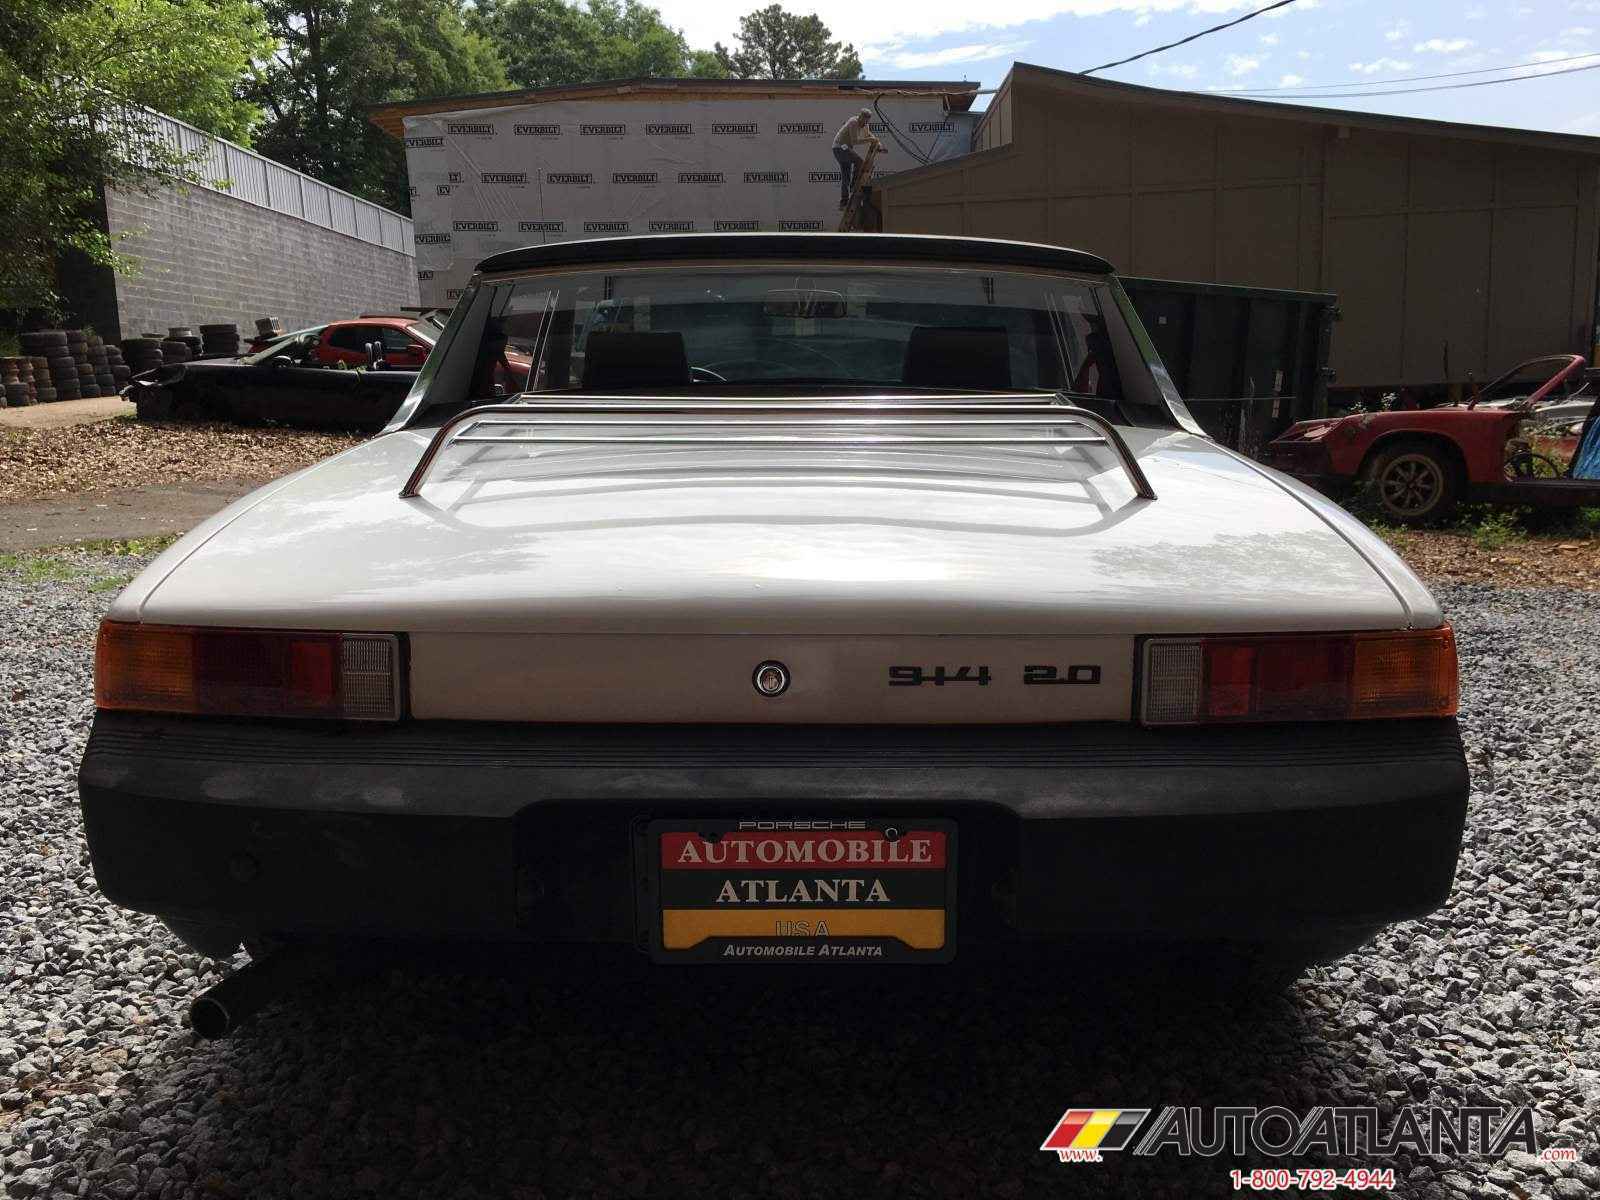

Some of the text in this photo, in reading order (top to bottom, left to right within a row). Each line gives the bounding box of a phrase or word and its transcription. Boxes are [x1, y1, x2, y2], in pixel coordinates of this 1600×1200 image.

[450, 125, 492, 133] EVERBILT
[516, 125, 558, 134] EVERBILT
[582, 125, 624, 134] EVERBILT
[647, 125, 690, 134] EVERBILT
[714, 124, 756, 133] EVERBILT
[779, 124, 821, 133] EVERBILT
[911, 123, 952, 132] EVERBILT
[483, 174, 525, 182] EVERBILT
[549, 175, 590, 183] EVERBILT
[614, 174, 656, 183] EVERBILT
[680, 174, 722, 183] EVERBILT
[745, 173, 787, 182] EVERBILT
[455, 222, 497, 231] EVERBILT
[520, 223, 562, 231] EVERBILT
[586, 223, 627, 231] EVERBILT
[651, 222, 692, 231] EVERBILT
[716, 222, 758, 231] EVERBILT
[780, 222, 822, 231] EVERBILT
[739, 820, 866, 830] PORSCHE
[677, 839, 932, 863] AUTOMOBILE
[716, 879, 890, 902] ATLANTA
[775, 920, 831, 936] USA
[723, 944, 882, 956] AUTOMOBILE ATLANTA
